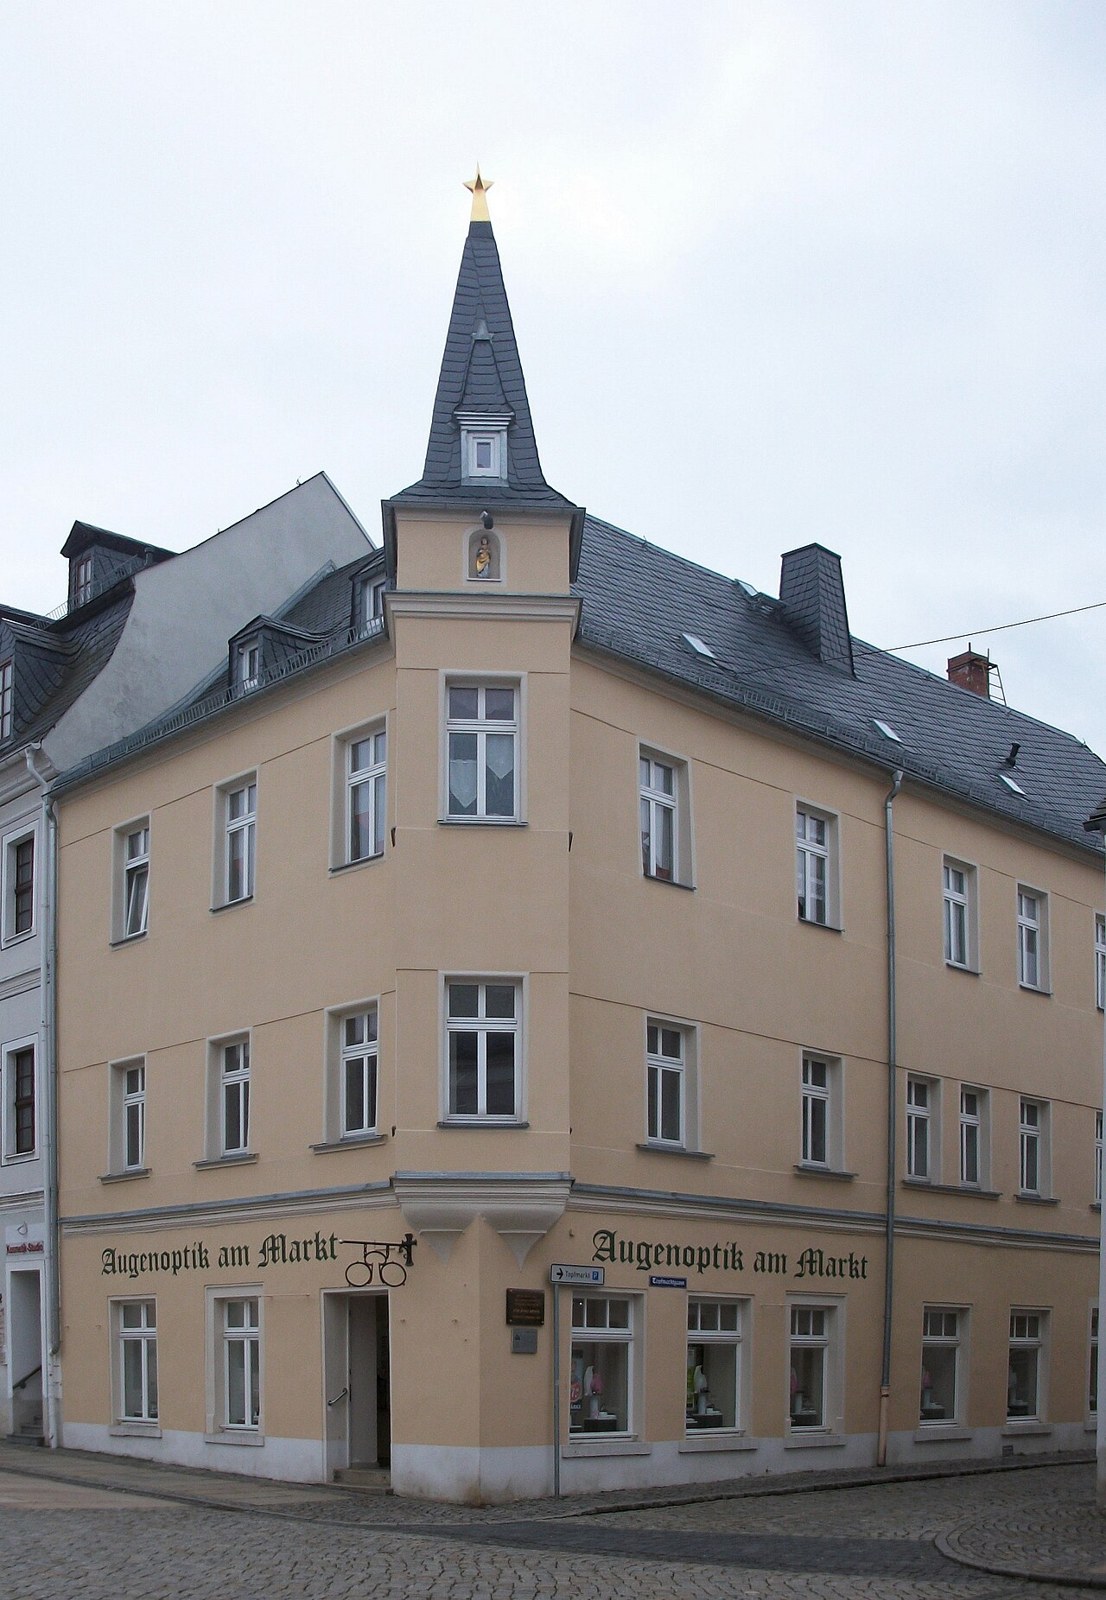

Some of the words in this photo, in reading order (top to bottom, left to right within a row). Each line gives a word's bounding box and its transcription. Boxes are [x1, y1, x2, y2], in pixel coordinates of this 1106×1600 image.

[101, 1240, 211, 1278] Augenoptik
[218, 1244, 251, 1269] am
[257, 1230, 339, 1268] Markt
[591, 1229, 744, 1274] Augenoptik
[753, 1249, 787, 1275] am
[794, 1247, 868, 1280] Markt
